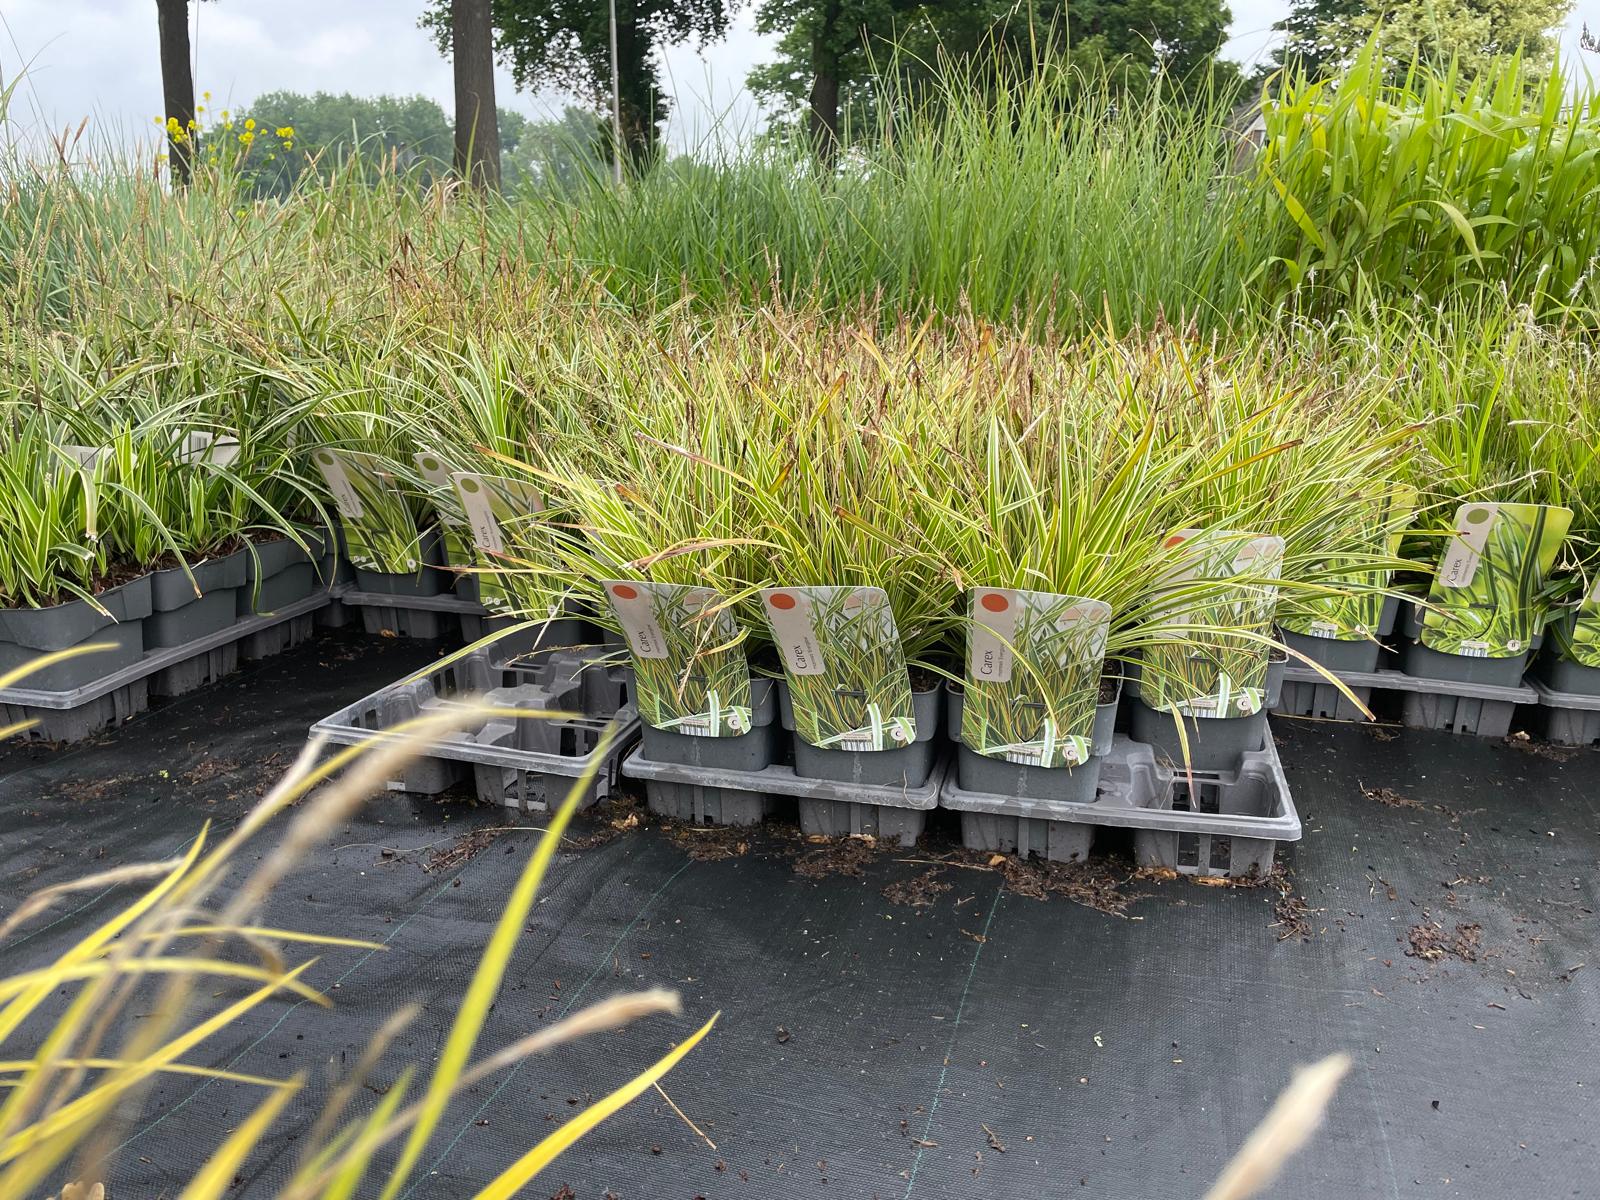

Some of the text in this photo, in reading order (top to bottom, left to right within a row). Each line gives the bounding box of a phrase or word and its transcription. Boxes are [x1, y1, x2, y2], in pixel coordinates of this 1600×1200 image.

[639, 631, 651, 653] Carex
[795, 645, 806, 669] Carex
[980, 650, 993, 675] Carex
